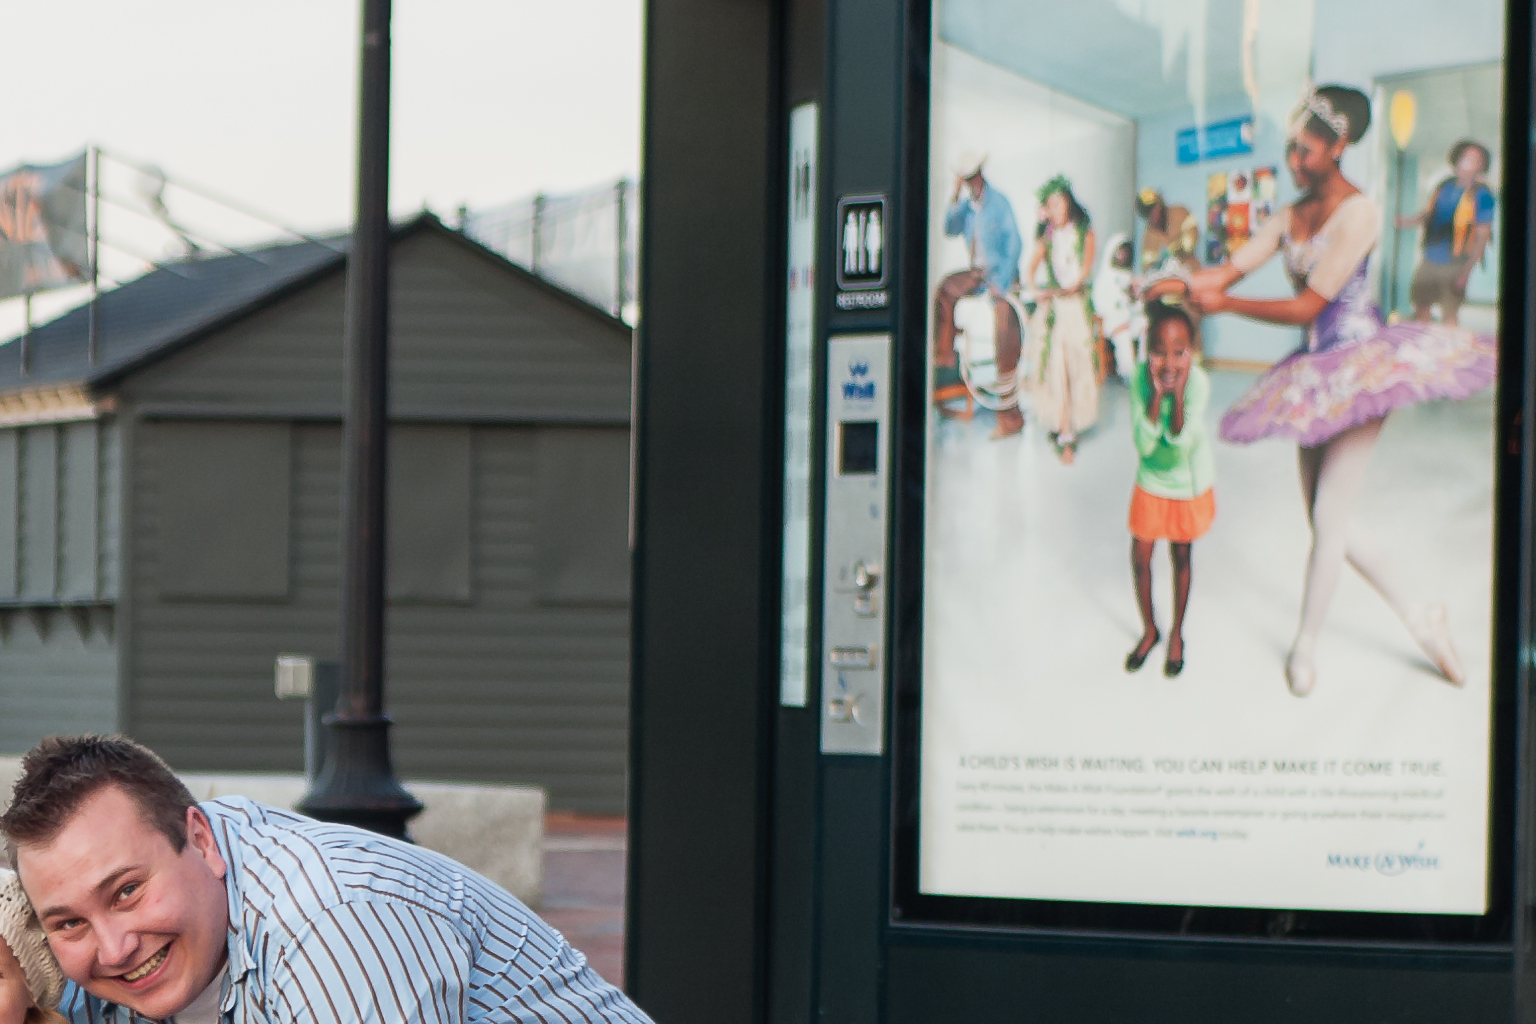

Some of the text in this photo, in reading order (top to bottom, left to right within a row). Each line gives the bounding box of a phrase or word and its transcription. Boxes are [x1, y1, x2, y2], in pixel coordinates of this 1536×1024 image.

[1024, 756, 1059, 770] WISH
[1063, 756, 1076, 771] IS
[1152, 758, 1185, 774] YOU
[1188, 758, 1223, 774] CAN
[1227, 759, 1268, 775] HELP
[1273, 760, 1319, 776] MAKE
[1323, 760, 1338, 776] IT
[1341, 760, 1393, 777] COME
[1400, 760, 1446, 778] TRUE.
